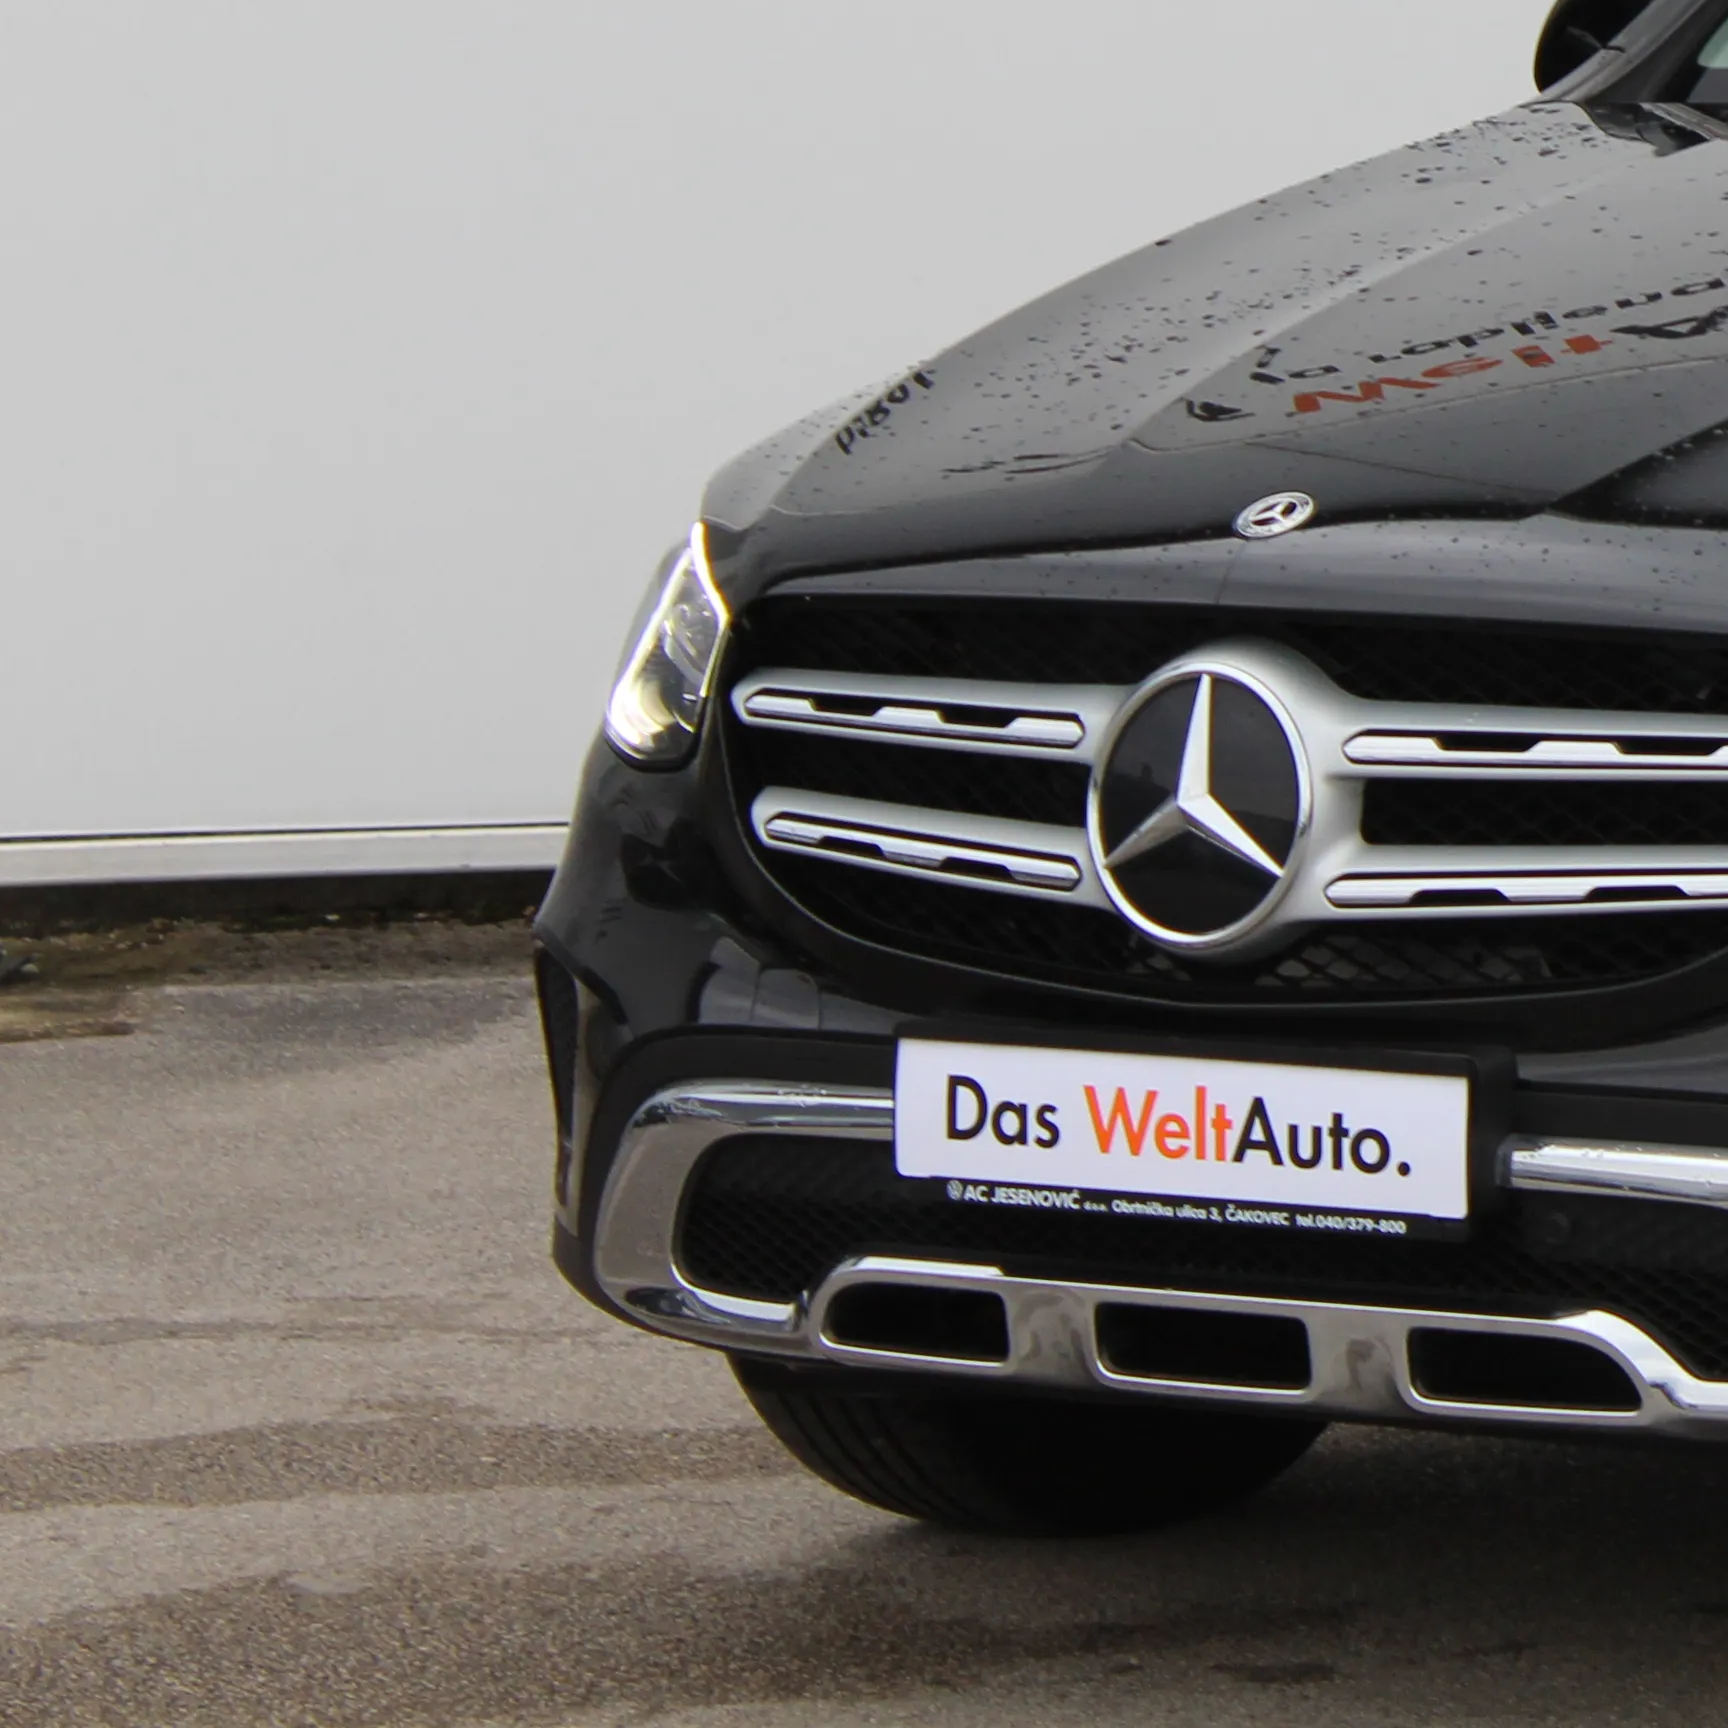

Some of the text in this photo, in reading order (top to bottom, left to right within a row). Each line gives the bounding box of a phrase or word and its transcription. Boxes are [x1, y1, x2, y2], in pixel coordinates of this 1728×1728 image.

[947, 1075, 1411, 1177] Das WeltAuto.
[964, 1184, 989, 1202] AC
[1225, 1204, 1290, 1226] ČAKOVEC
